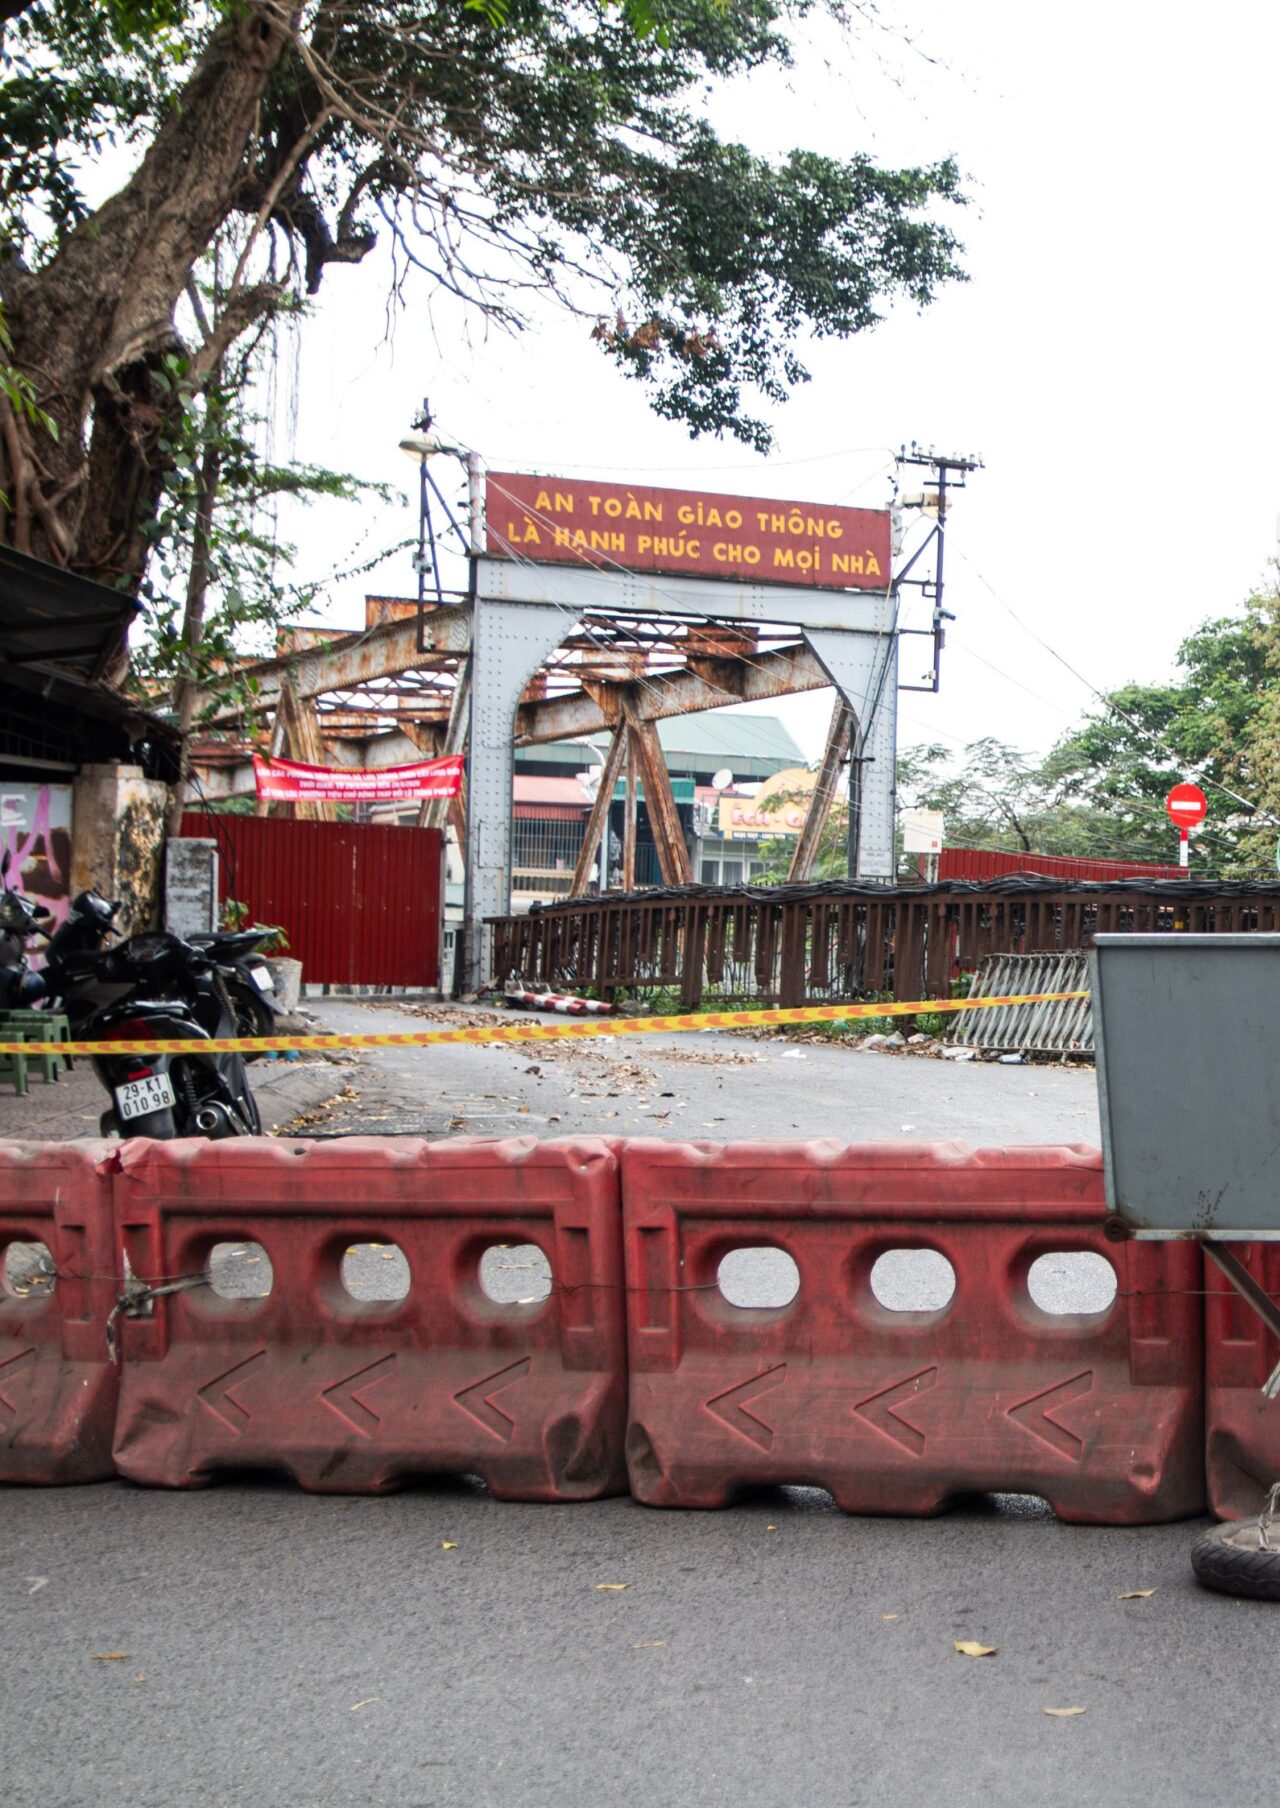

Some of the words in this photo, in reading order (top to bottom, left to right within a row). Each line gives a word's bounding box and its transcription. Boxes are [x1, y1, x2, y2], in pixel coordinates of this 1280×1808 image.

[534, 491, 574, 513] AN
[589, 492, 663, 522] TOÀN
[757, 508, 844, 538] THÔNG
[507, 516, 541, 545] LÀ
[555, 526, 625, 554] HẠNH
[638, 530, 701, 559] PHÚC
[712, 542, 761, 564] CHO
[832, 550, 881, 576] NHÀ
[123, 1077, 161, 1100] 29-K1
[123, 1091, 170, 1117] 010.98
